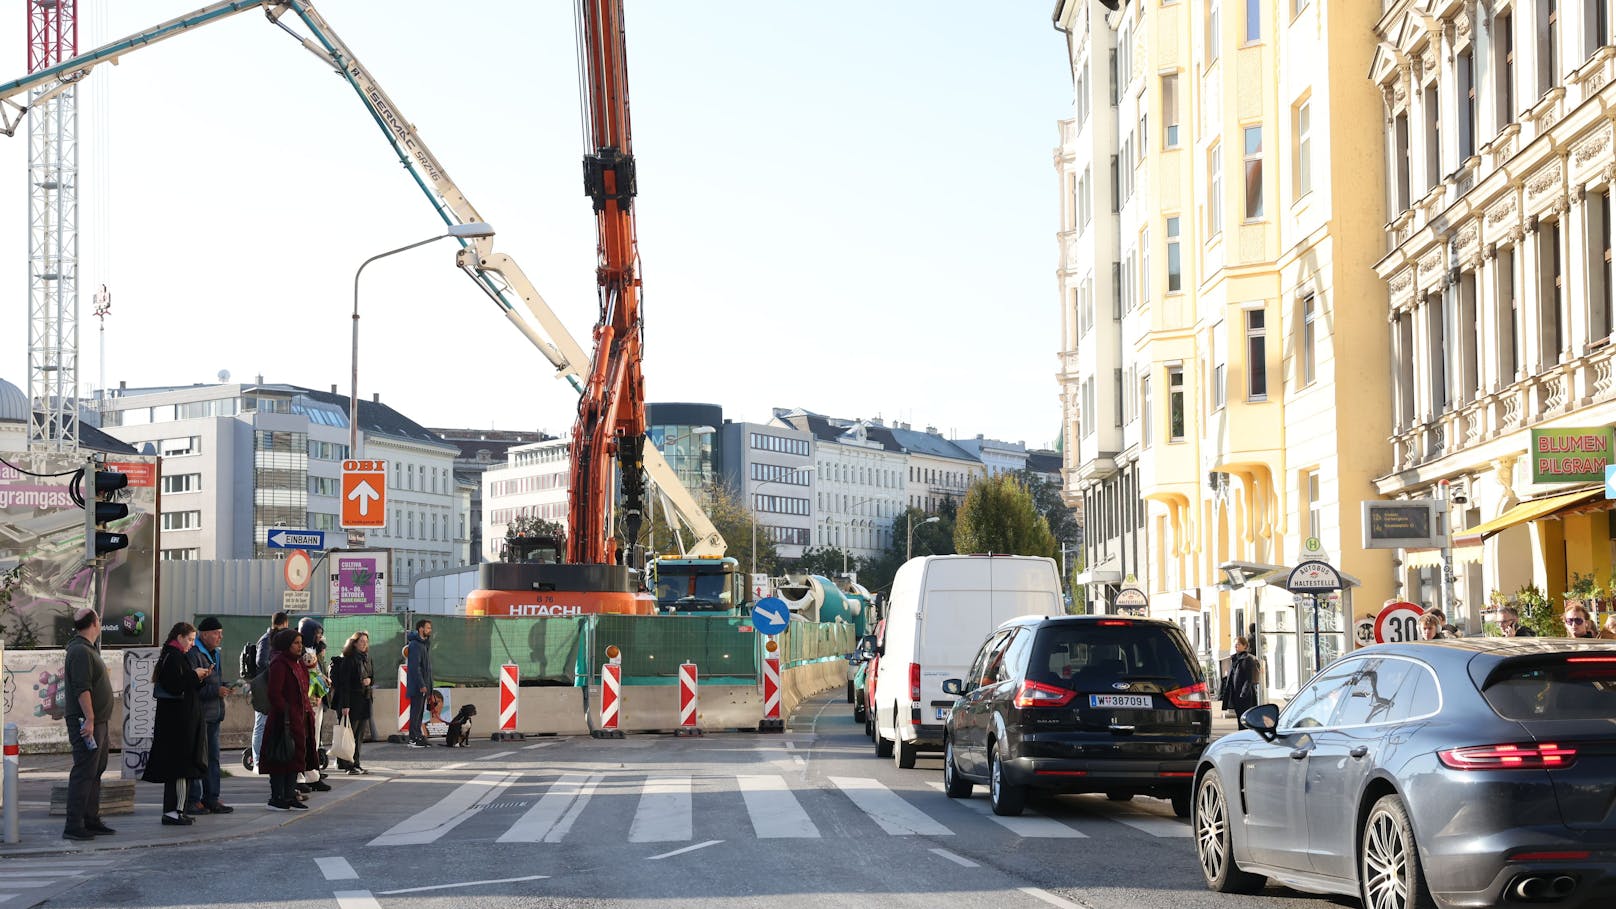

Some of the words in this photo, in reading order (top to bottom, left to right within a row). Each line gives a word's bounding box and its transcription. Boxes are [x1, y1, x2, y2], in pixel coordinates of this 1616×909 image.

[369, 91, 416, 150] SERMAC
[1537, 435, 1607, 453] BLUMEN
[343, 460, 385, 471] OBI
[1538, 456, 1607, 475] PILGRAM
[0, 467, 19, 479] au
[0, 490, 84, 509] gramgass
[286, 535, 318, 545] EINBAHN
[1309, 540, 1317, 548] H
[1299, 564, 1331, 576] AUTOBUS
[509, 604, 582, 617] HITACHI
[123, 620, 132, 629] U2
[1389, 616, 1418, 643] 30
[1098, 697, 1105, 706] W
